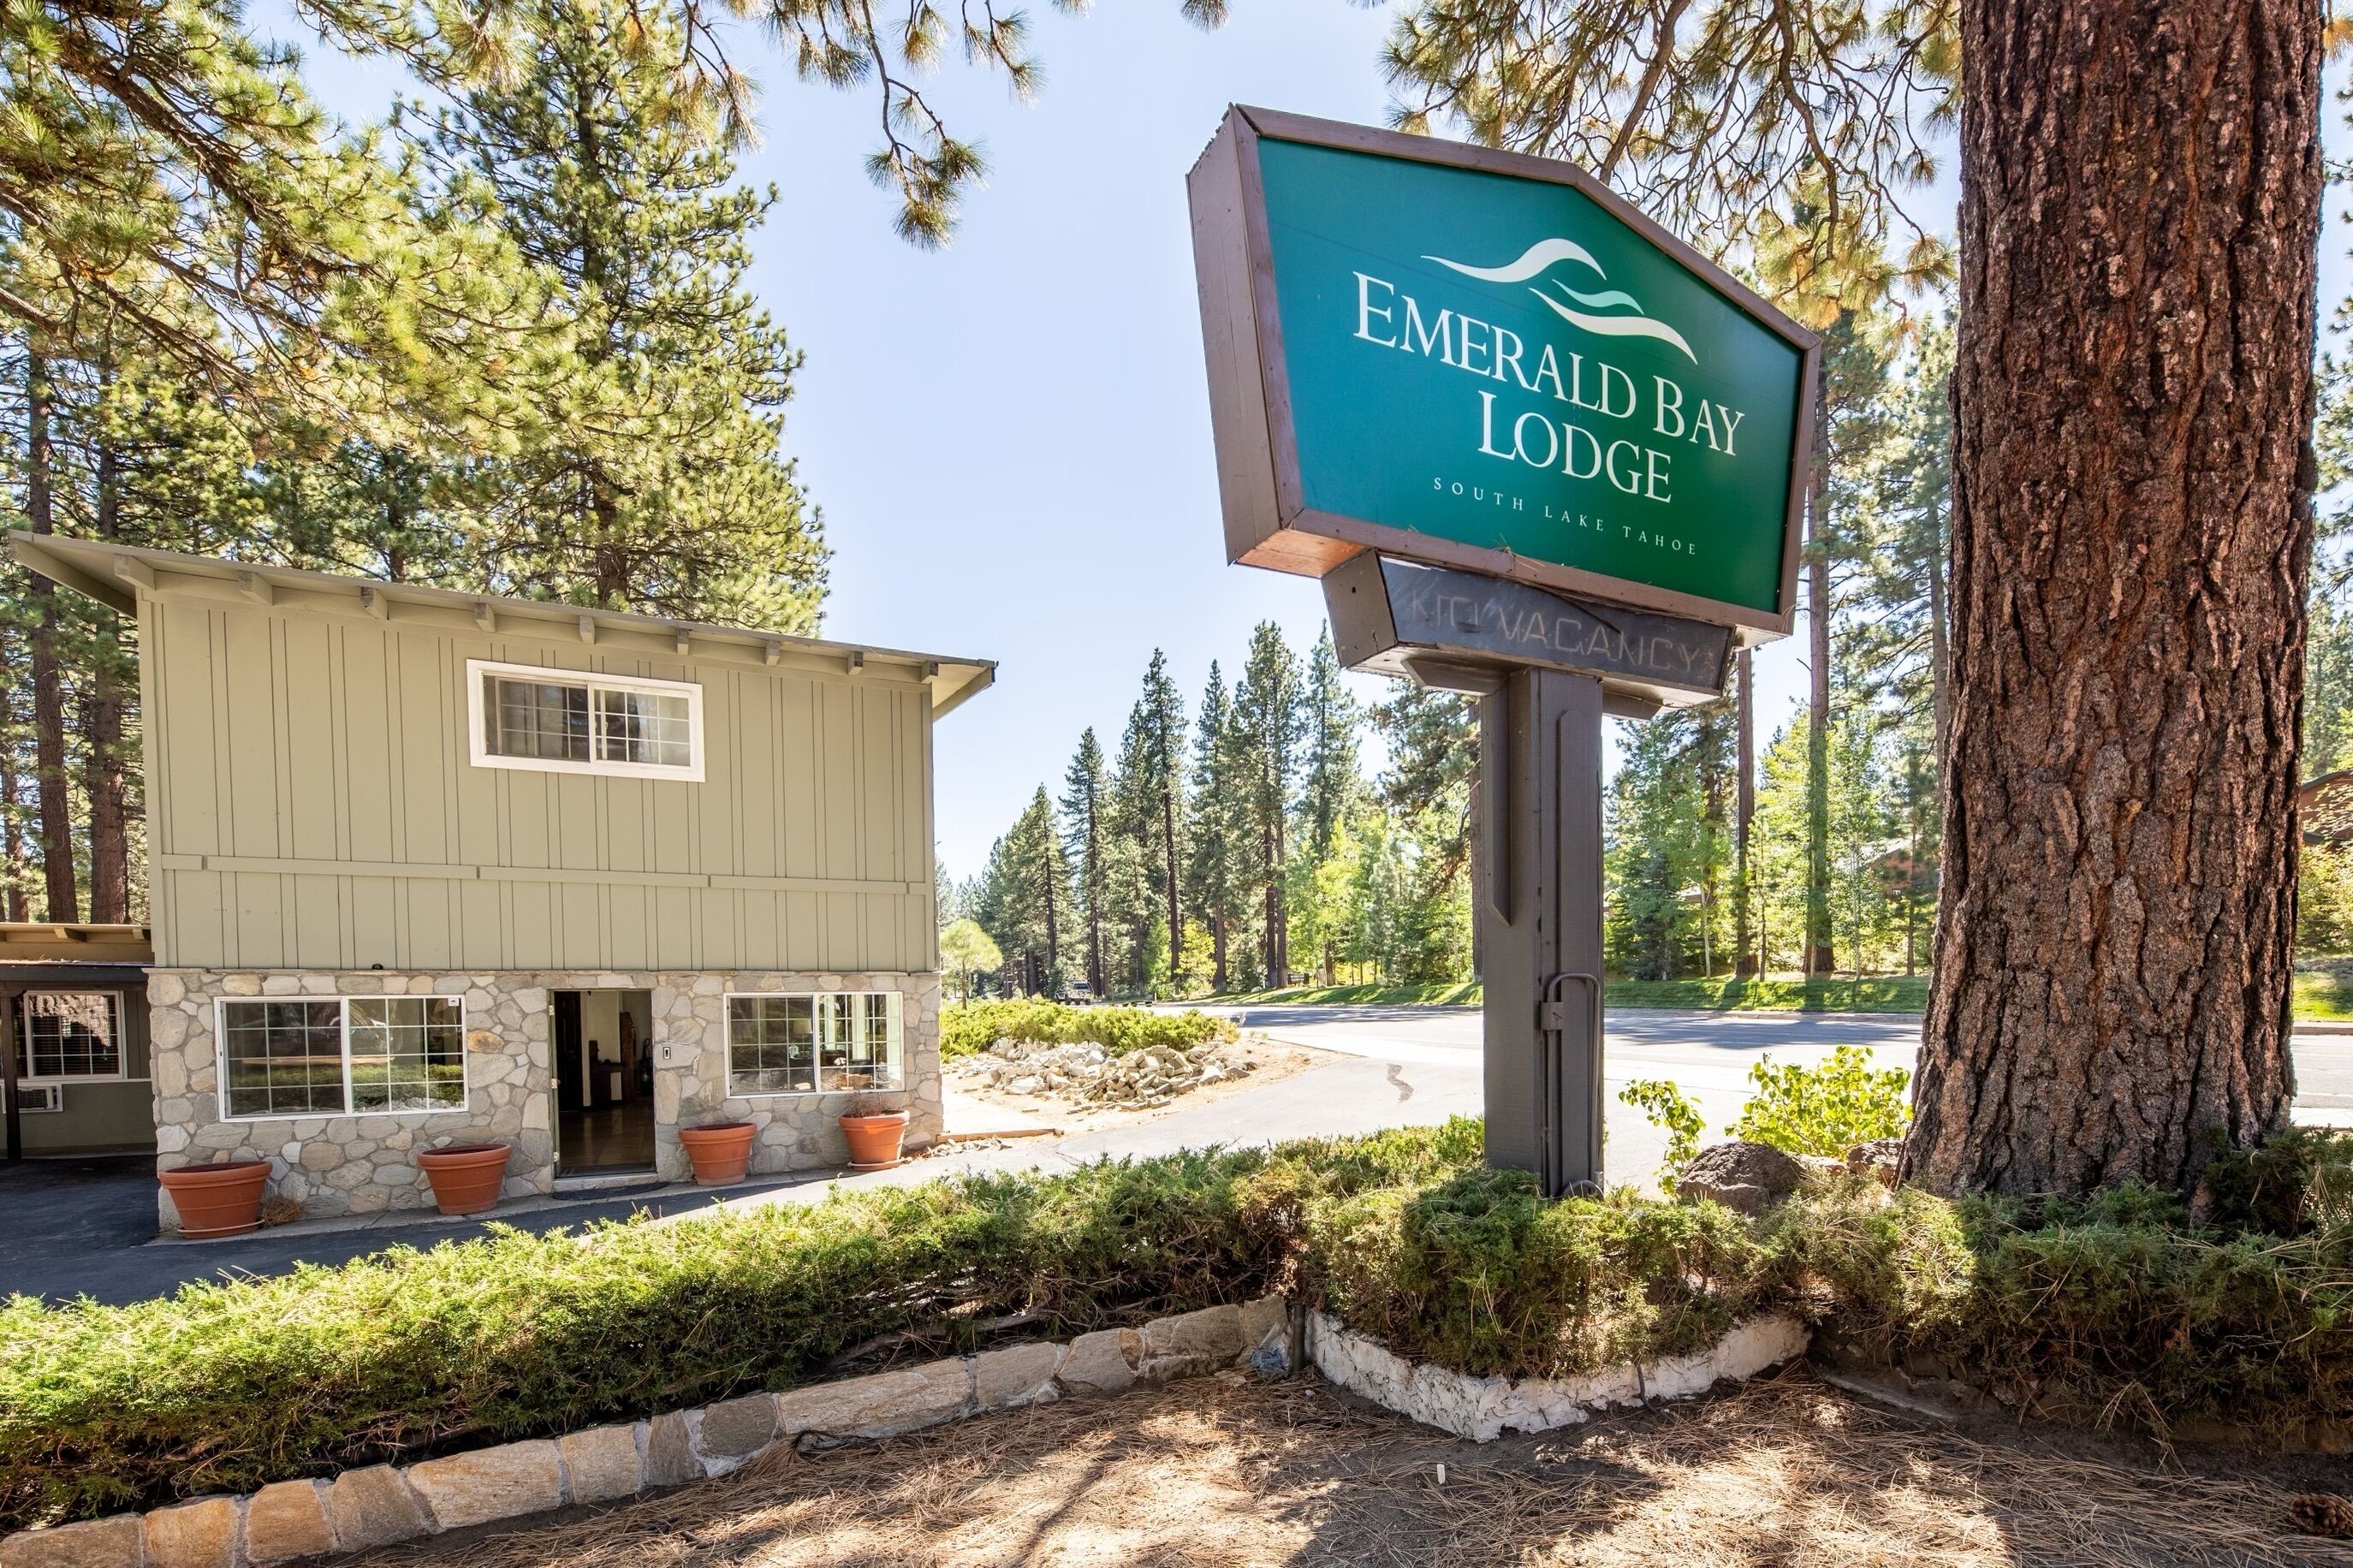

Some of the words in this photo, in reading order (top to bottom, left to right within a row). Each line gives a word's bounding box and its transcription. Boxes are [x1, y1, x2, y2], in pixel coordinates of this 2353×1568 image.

[1352, 270, 1637, 419] EMERALD
[1653, 375, 1745, 456] BAY
[1477, 390, 1672, 503] LODGE
[1434, 477, 1524, 511] SOUTH
[1545, 506, 1604, 532] LAKE
[1623, 525, 1696, 555] TAHOE
[1499, 603, 1700, 673] VACANCY
